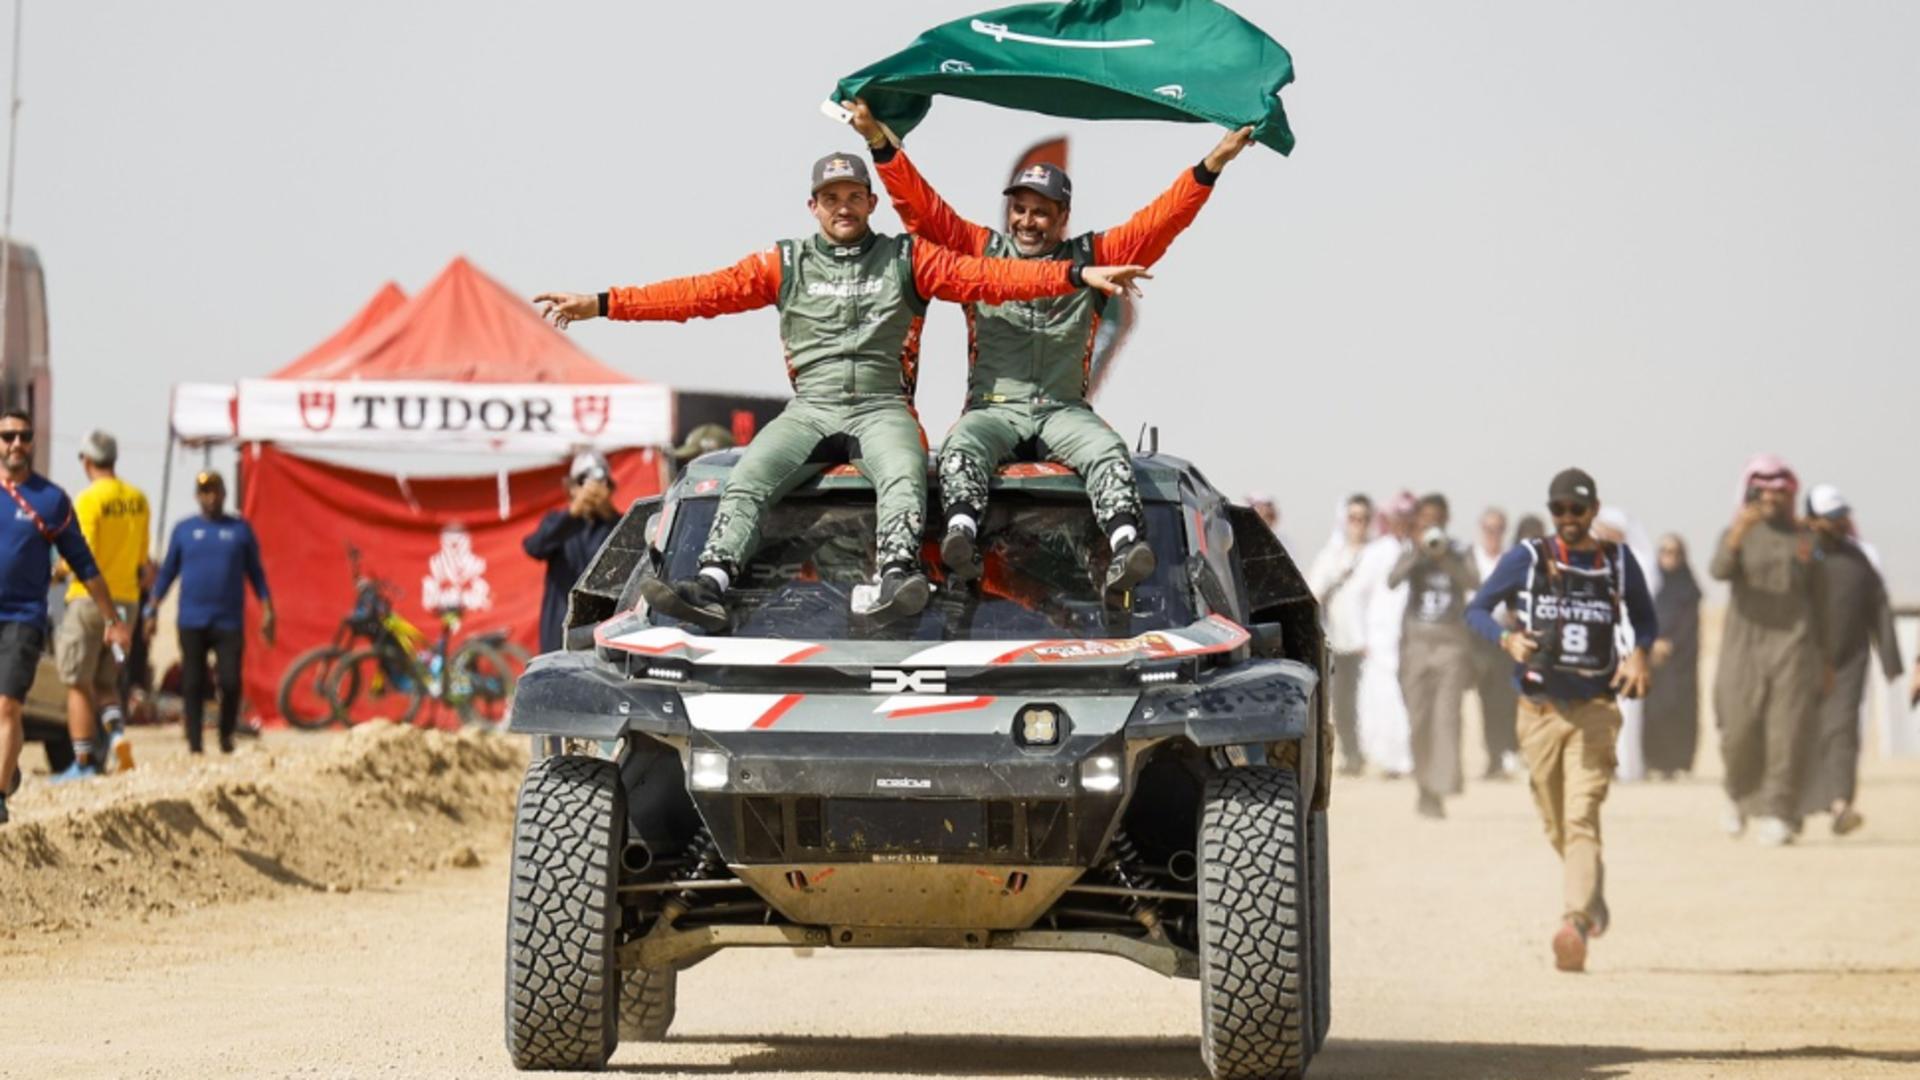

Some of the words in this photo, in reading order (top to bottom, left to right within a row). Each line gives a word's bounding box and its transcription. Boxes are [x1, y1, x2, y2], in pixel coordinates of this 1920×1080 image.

[353, 396, 557, 433] TUDOR
[1536, 604, 1613, 623] CONTENT
[1561, 623, 1588, 653] 8
